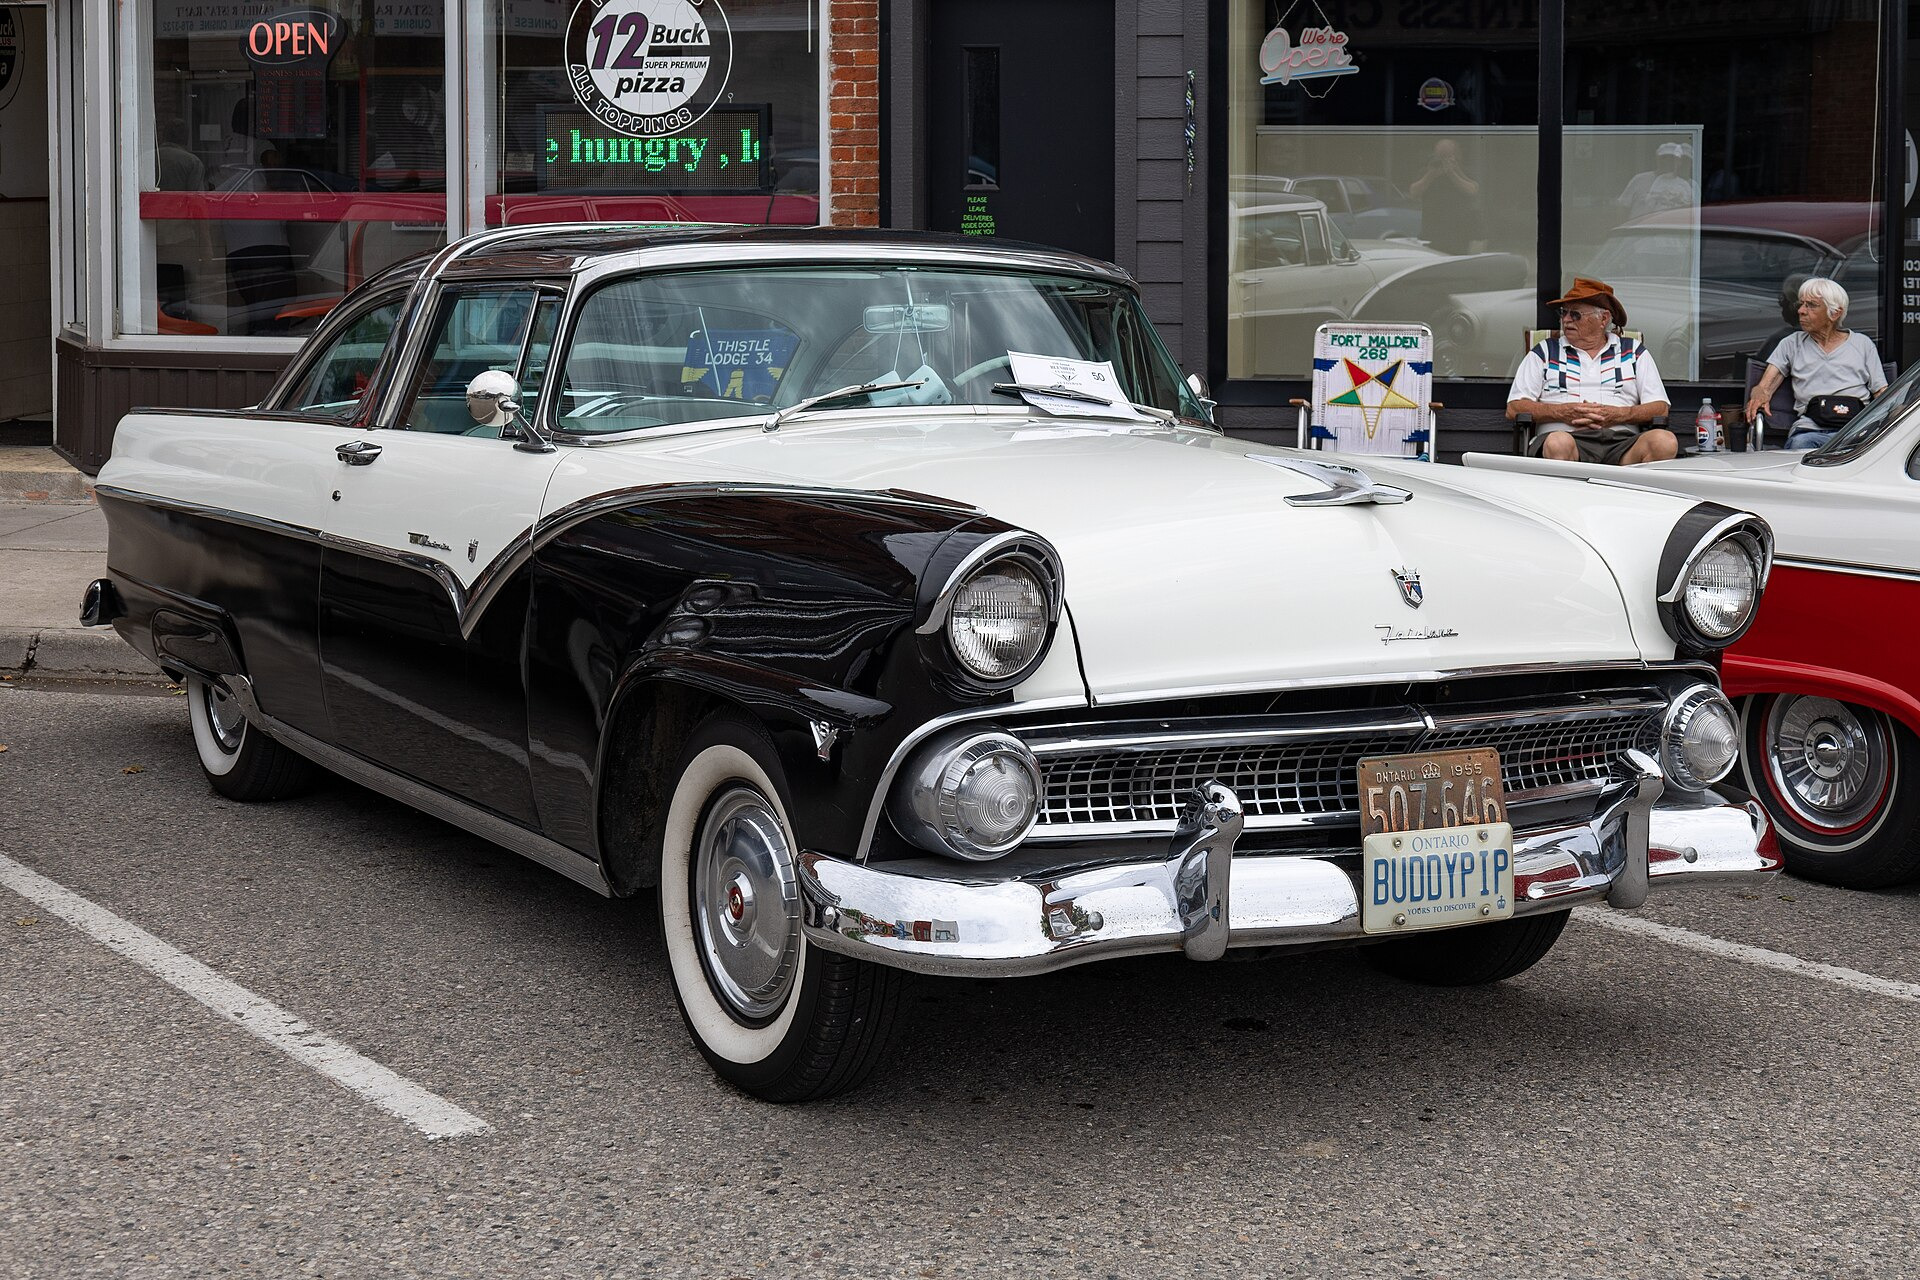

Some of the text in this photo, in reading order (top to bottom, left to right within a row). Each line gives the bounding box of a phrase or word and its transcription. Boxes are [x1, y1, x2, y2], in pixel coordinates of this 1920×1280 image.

[249, 22, 329, 55] OPEN
[591, 11, 649, 70] 12
[651, 23, 706, 44] Buck
[1302, 27, 1346, 44] We're
[644, 60, 708, 70] SUPER PREMIUM
[1262, 30, 1353, 83] Open
[613, 72, 687, 99] pizza
[570, 63, 693, 134] ALL TOPPINGS
[570, 129, 708, 172] hungry
[717, 339, 771, 352] THISTLE
[1330, 334, 1419, 348] FORT MALDEN
[704, 352, 773, 365] LODGE 34
[1359, 347, 1389, 360] 268
[1091, 371, 1106, 382] 50
[1376, 763, 1483, 784] ONTARIO 1955
[1373, 848, 1509, 906] BUDDYPIP
[1407, 902, 1476, 916] YOURS TO DISCOVER
